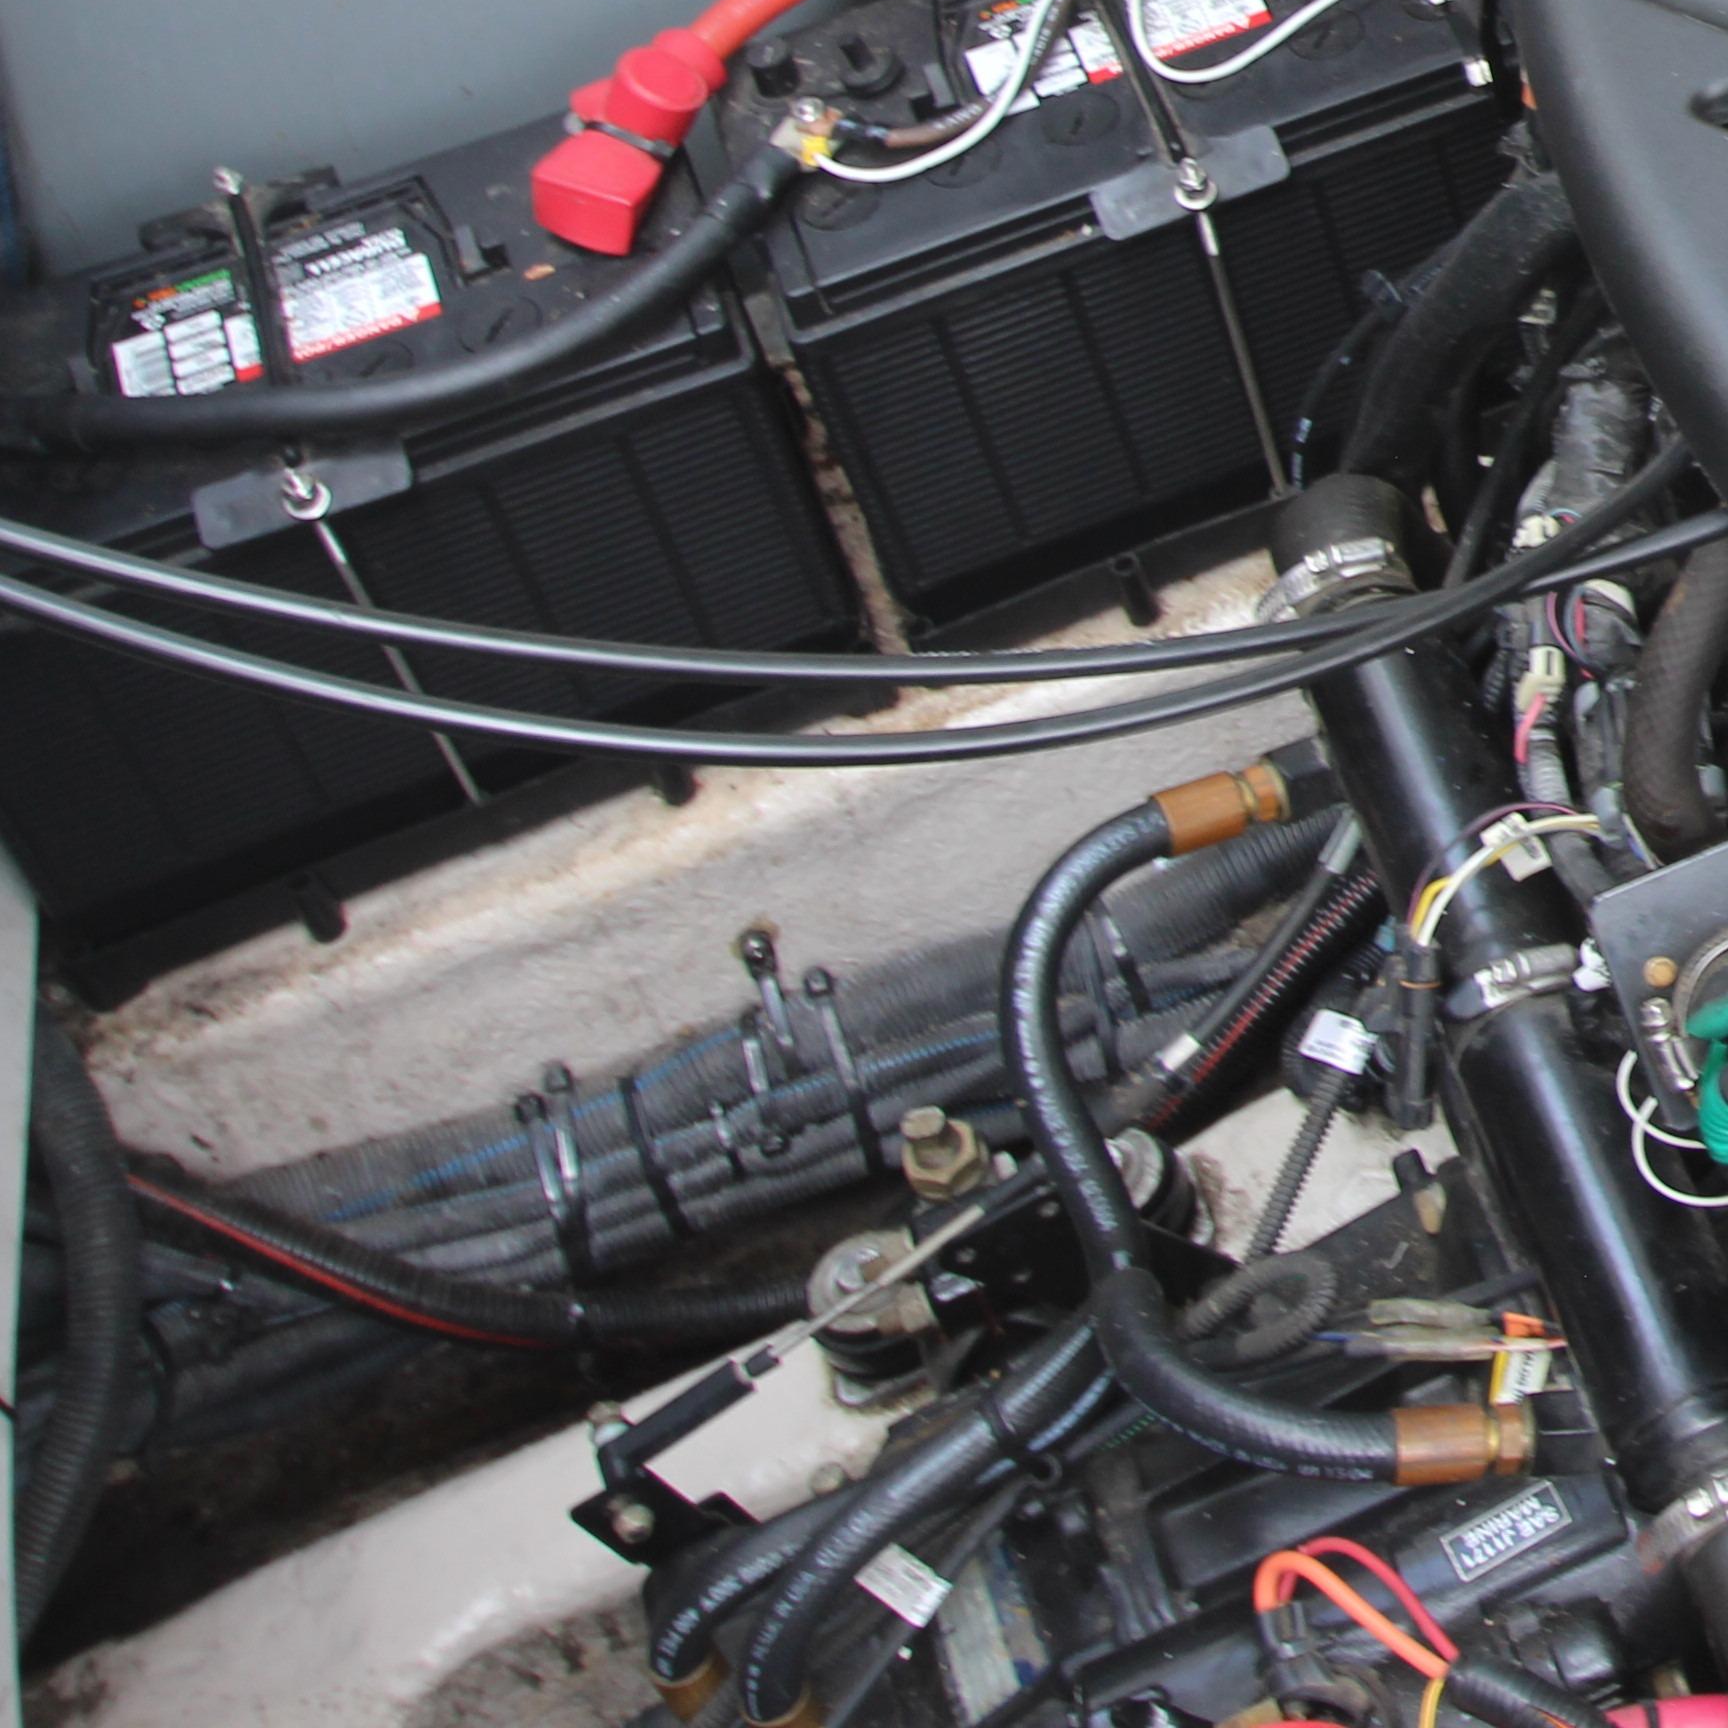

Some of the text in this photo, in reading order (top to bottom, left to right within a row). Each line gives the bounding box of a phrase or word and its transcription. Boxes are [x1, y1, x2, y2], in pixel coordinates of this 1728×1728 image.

[1458, 1501, 1561, 1570] SAE J1171
[1459, 1492, 1543, 1550] MARINE
